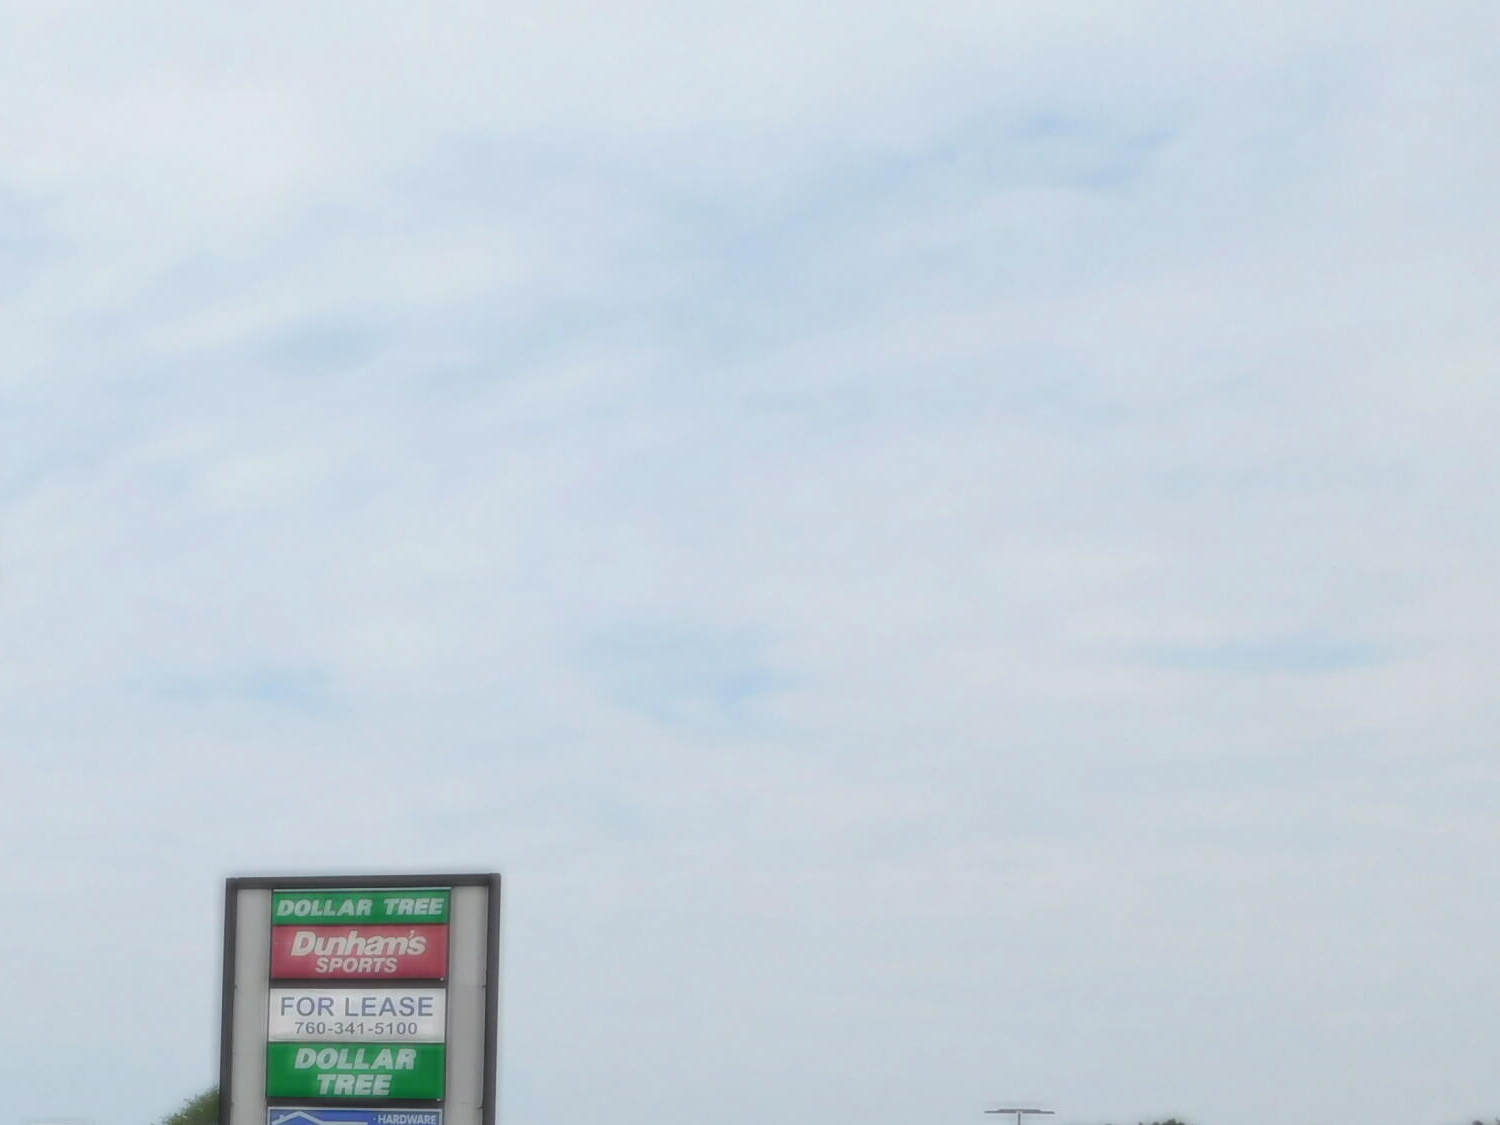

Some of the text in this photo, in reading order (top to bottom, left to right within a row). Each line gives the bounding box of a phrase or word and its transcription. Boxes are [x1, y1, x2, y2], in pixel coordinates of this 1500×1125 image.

[276, 898, 445, 916] DOLLAR TREE
[290, 930, 427, 956] Dunham's
[315, 957, 398, 973] SPORTS
[280, 997, 434, 1017] FOR LEASE
[294, 1021, 418, 1035] 760-341-5100
[295, 1048, 416, 1070] DOLLAR
[317, 1074, 393, 1095] TREE
